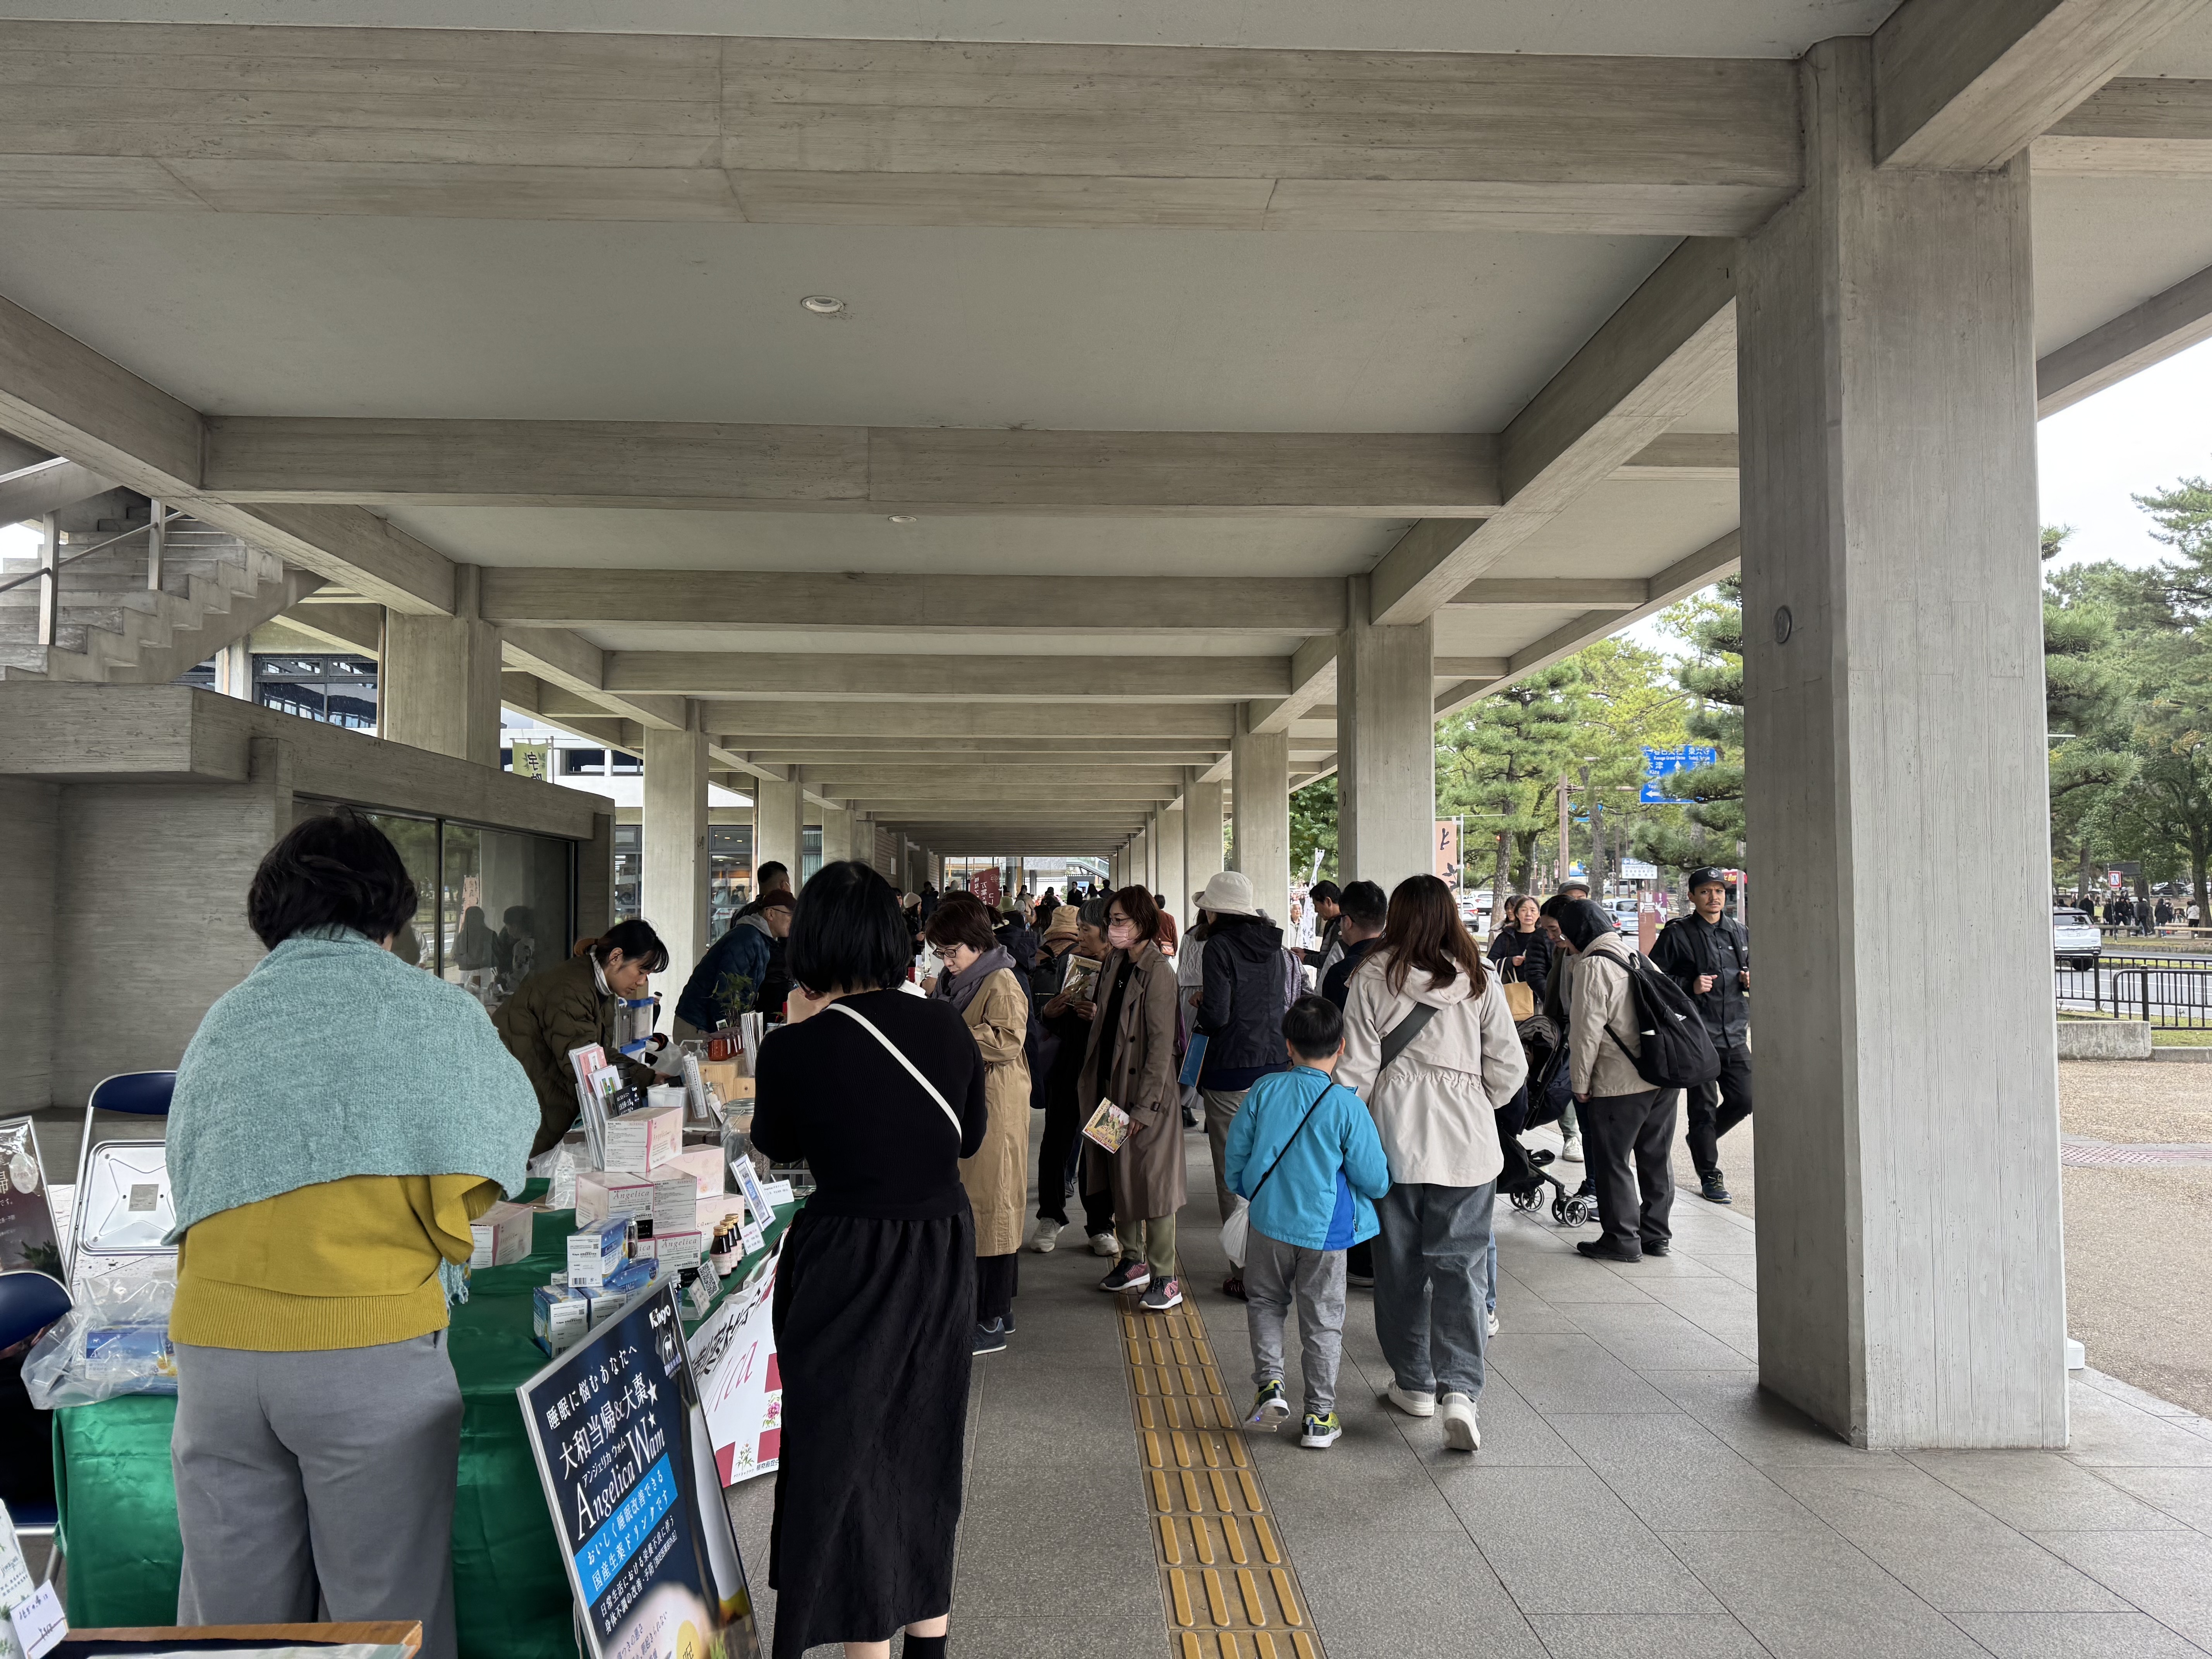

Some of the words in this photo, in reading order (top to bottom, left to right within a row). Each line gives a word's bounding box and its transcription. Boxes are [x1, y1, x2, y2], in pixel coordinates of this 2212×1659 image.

[613, 1190, 649, 1200] Angelica
[662, 1238, 697, 1248] Angelica
[649, 1305, 671, 1329] Kinyo
[546, 1346, 637, 1430] 睡眠に悩むあなたへ
[577, 1461, 636, 1541] Angelica
[626, 1417, 665, 1473] Wam
[582, 1452, 612, 1488] アンジェリカ
[611, 1437, 627, 1458] ウォム
[587, 1469, 663, 1565] おいしく睡眠改善できる
[592, 1490, 668, 1592] 国産生薬ドリンクです
[601, 1515, 674, 1618] 日常生活における栄養不良に伴う
